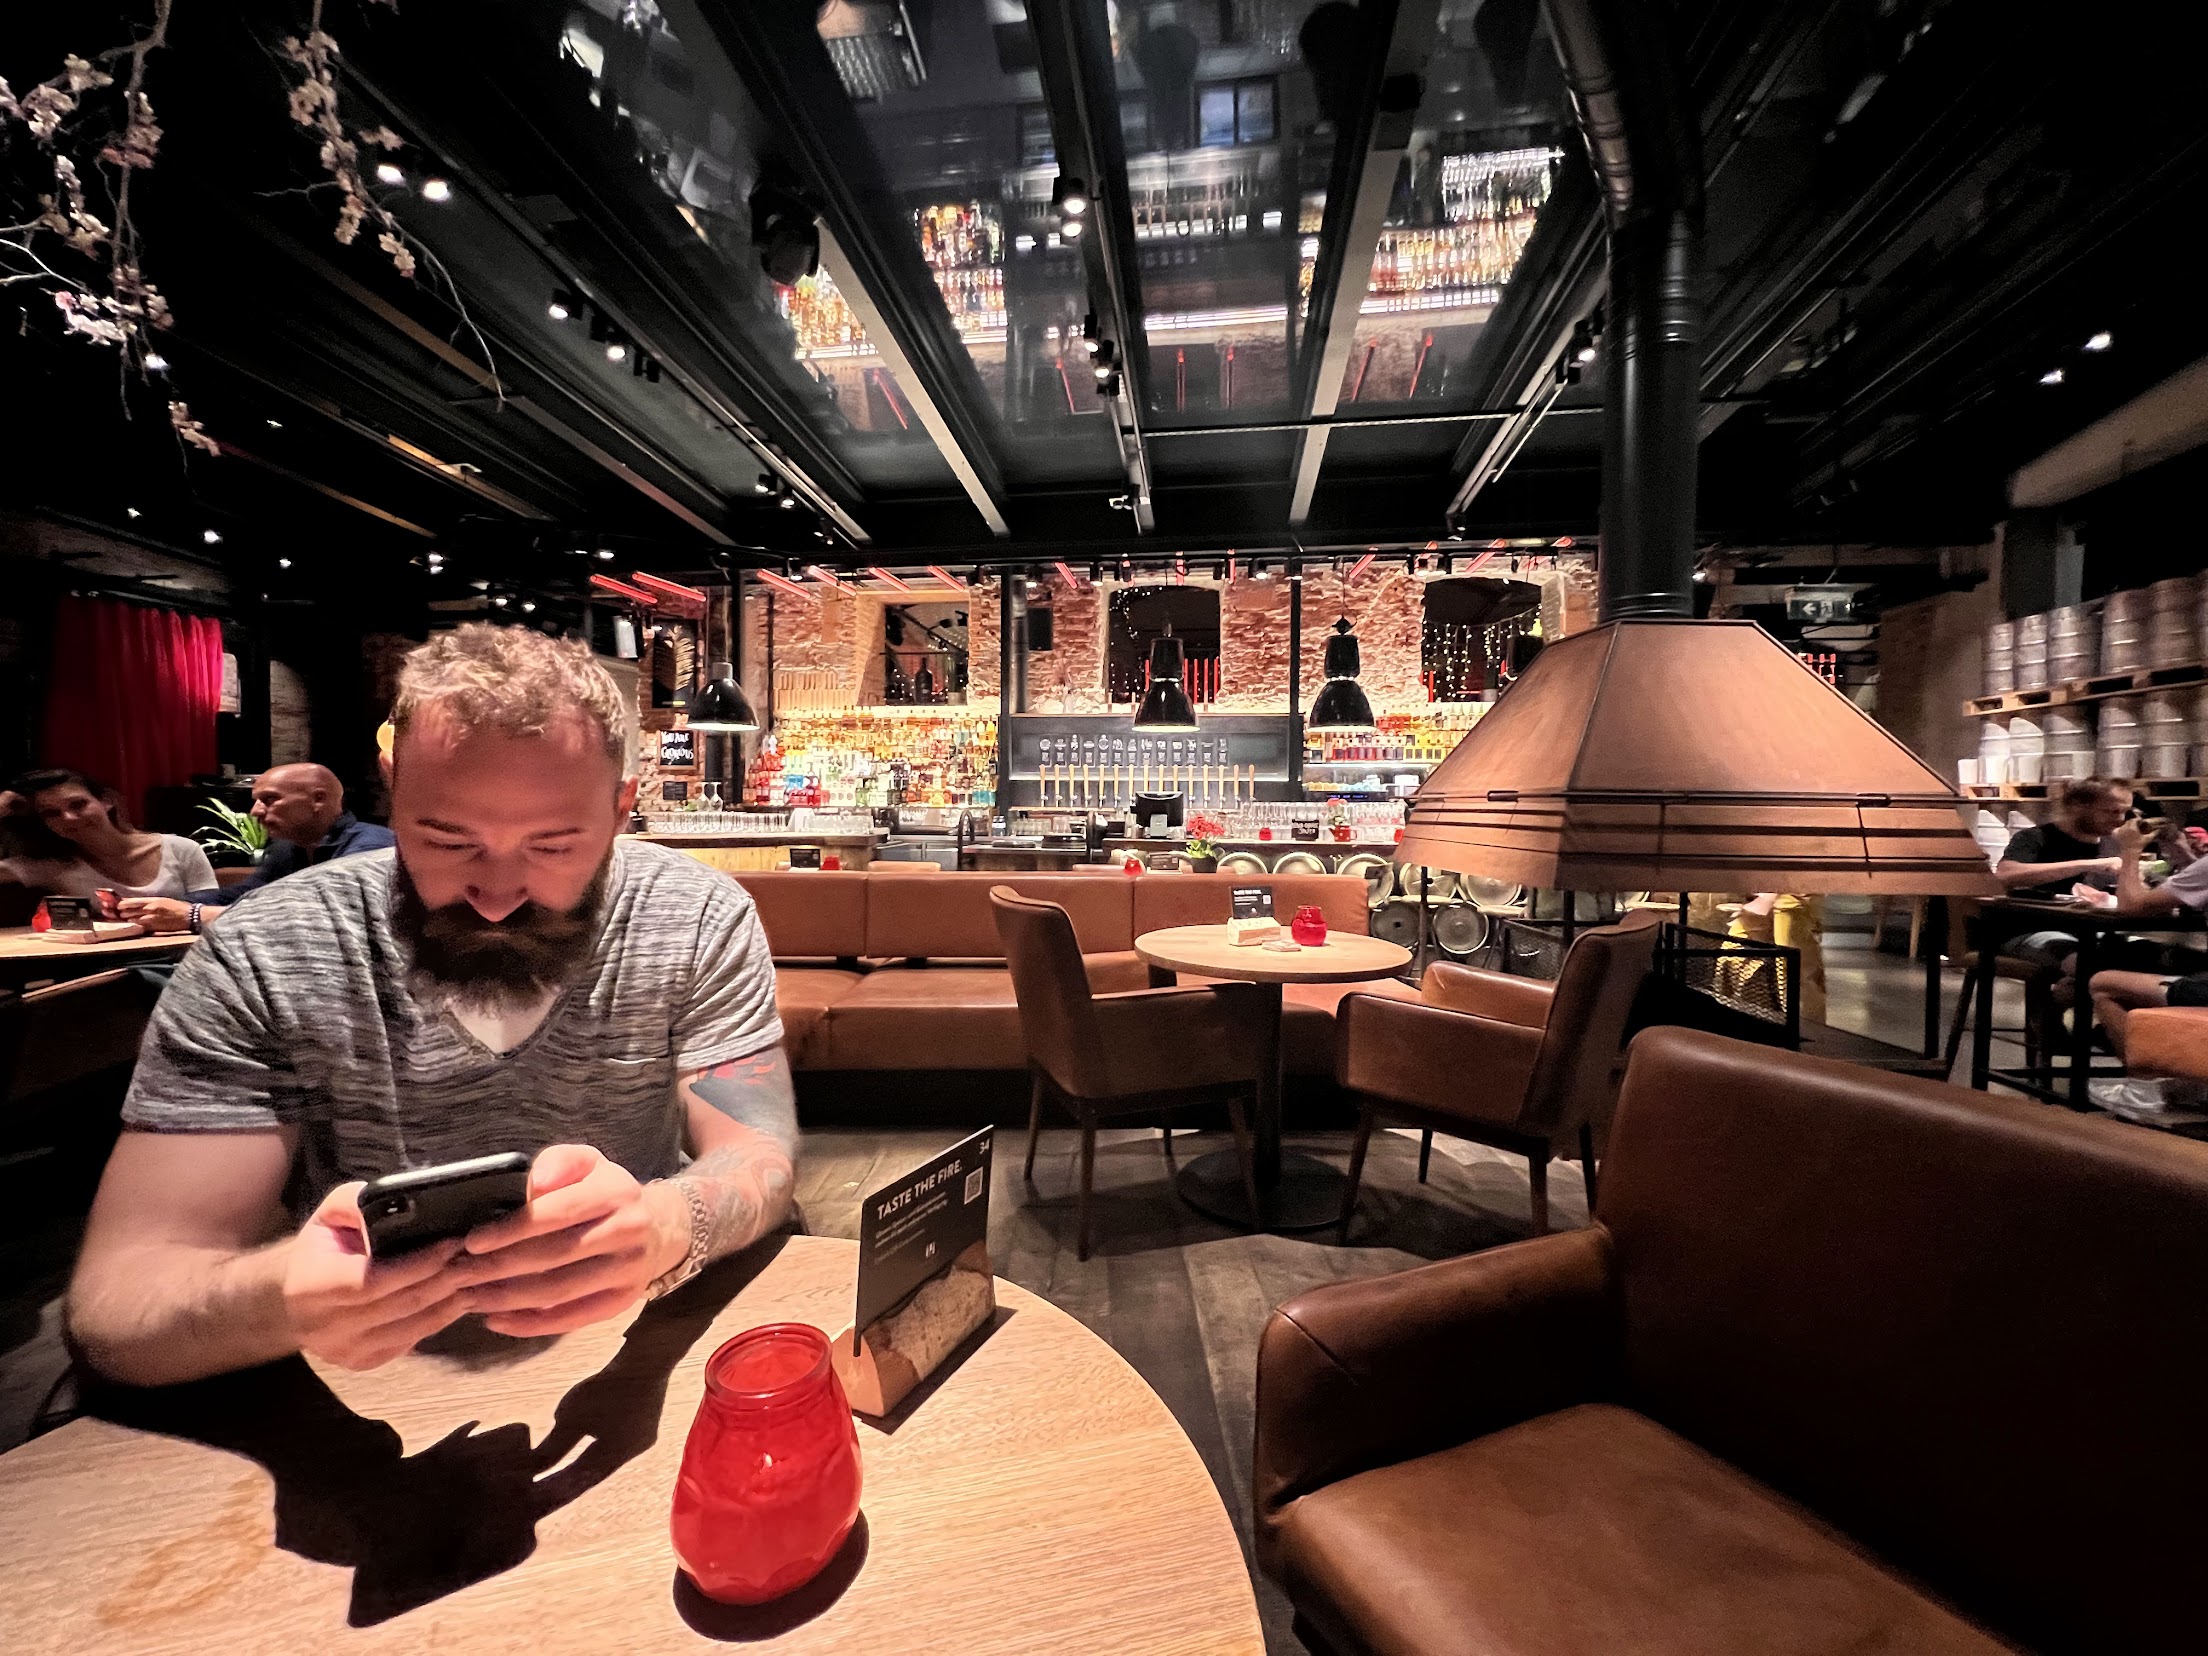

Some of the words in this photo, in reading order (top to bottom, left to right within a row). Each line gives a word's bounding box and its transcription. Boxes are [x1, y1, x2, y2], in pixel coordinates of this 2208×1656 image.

[661, 731, 674, 744] YOU
[979, 1138, 990, 1154] 34
[877, 1187, 912, 1220] TASTE
[915, 1173, 936, 1198] THE
[938, 1159, 963, 1184] FIRE.
